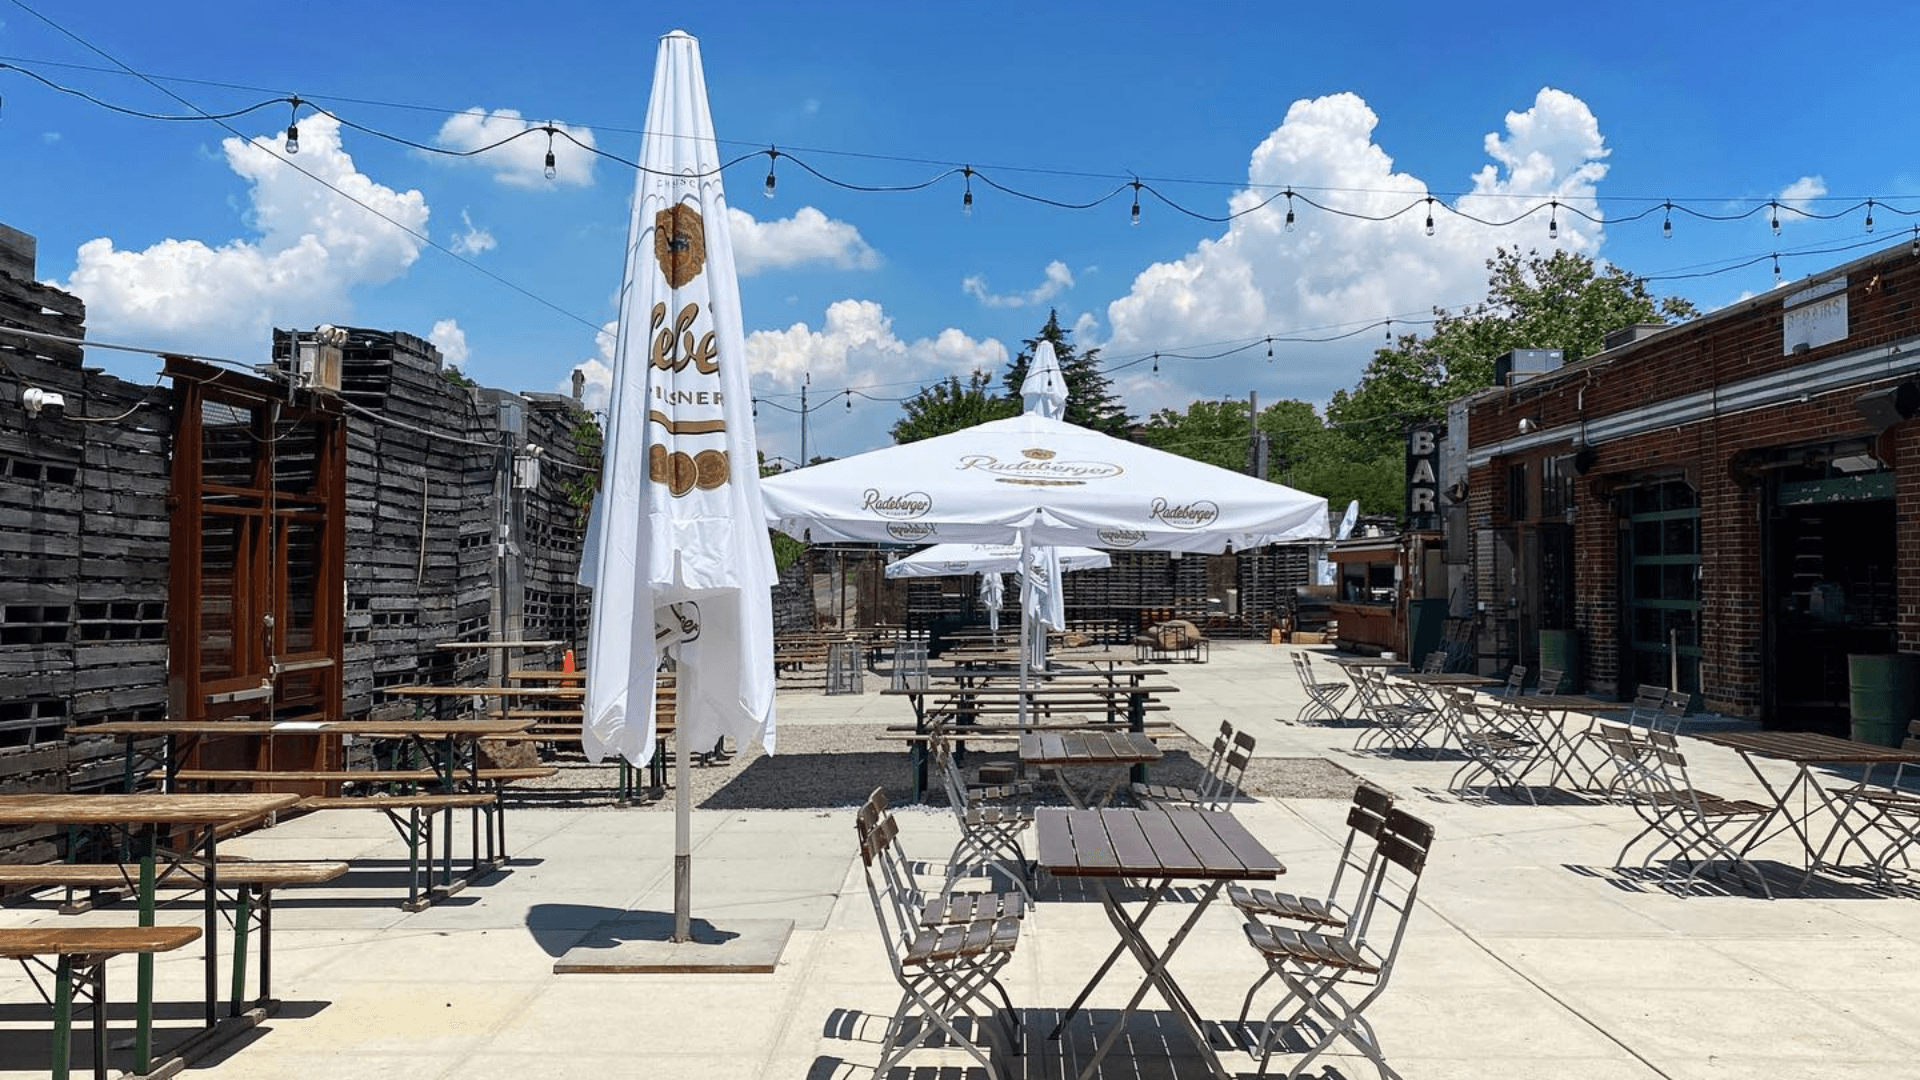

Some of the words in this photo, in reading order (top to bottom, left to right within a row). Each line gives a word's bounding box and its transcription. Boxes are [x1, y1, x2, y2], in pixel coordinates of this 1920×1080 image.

[649, 386, 724, 406] ILSNER
[955, 455, 1122, 478] Radeberger
[1411, 431, 1436, 512] BAR
[861, 488, 931, 518] Radeberger
[1149, 497, 1218, 527] Radeberger
